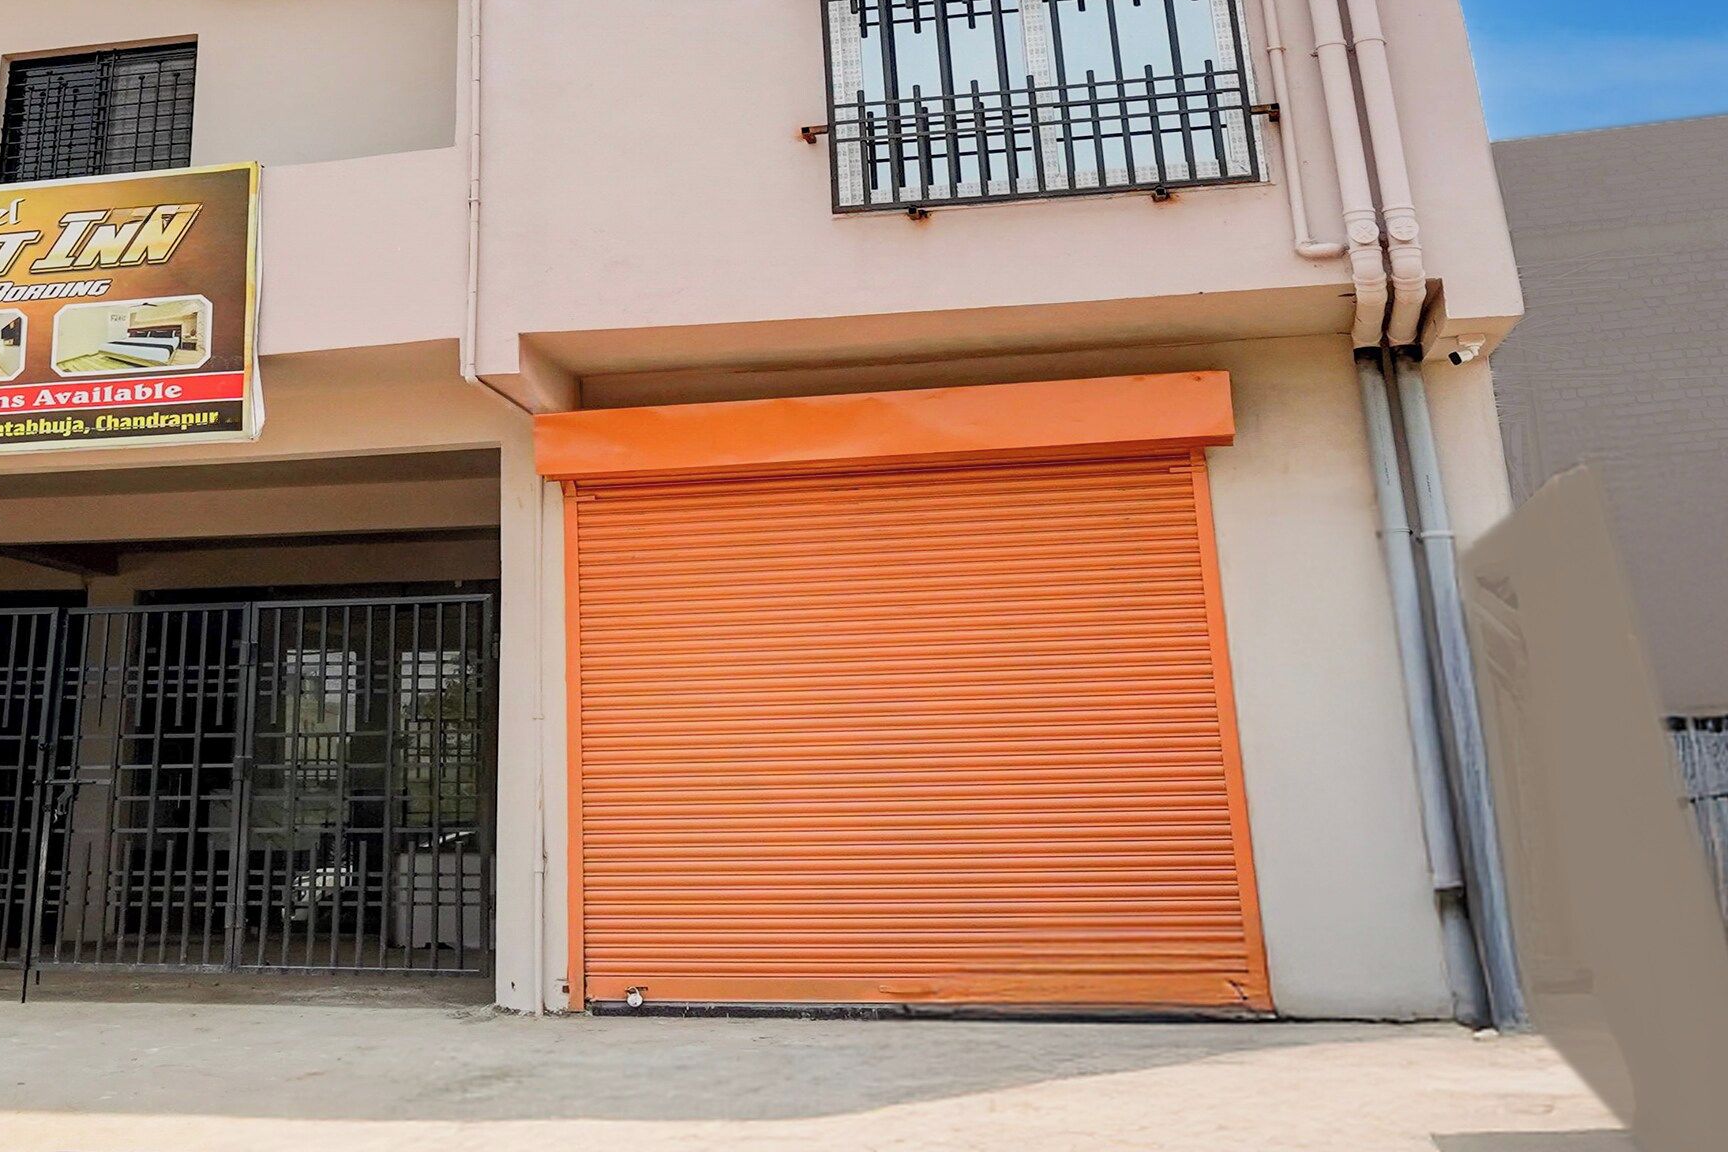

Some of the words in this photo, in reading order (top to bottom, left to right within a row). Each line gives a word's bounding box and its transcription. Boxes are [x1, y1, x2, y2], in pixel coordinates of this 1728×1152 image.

[29, 203, 204, 274] INN
[33, 381, 184, 407] Available
[95, 410, 219, 431] Chandrapur
